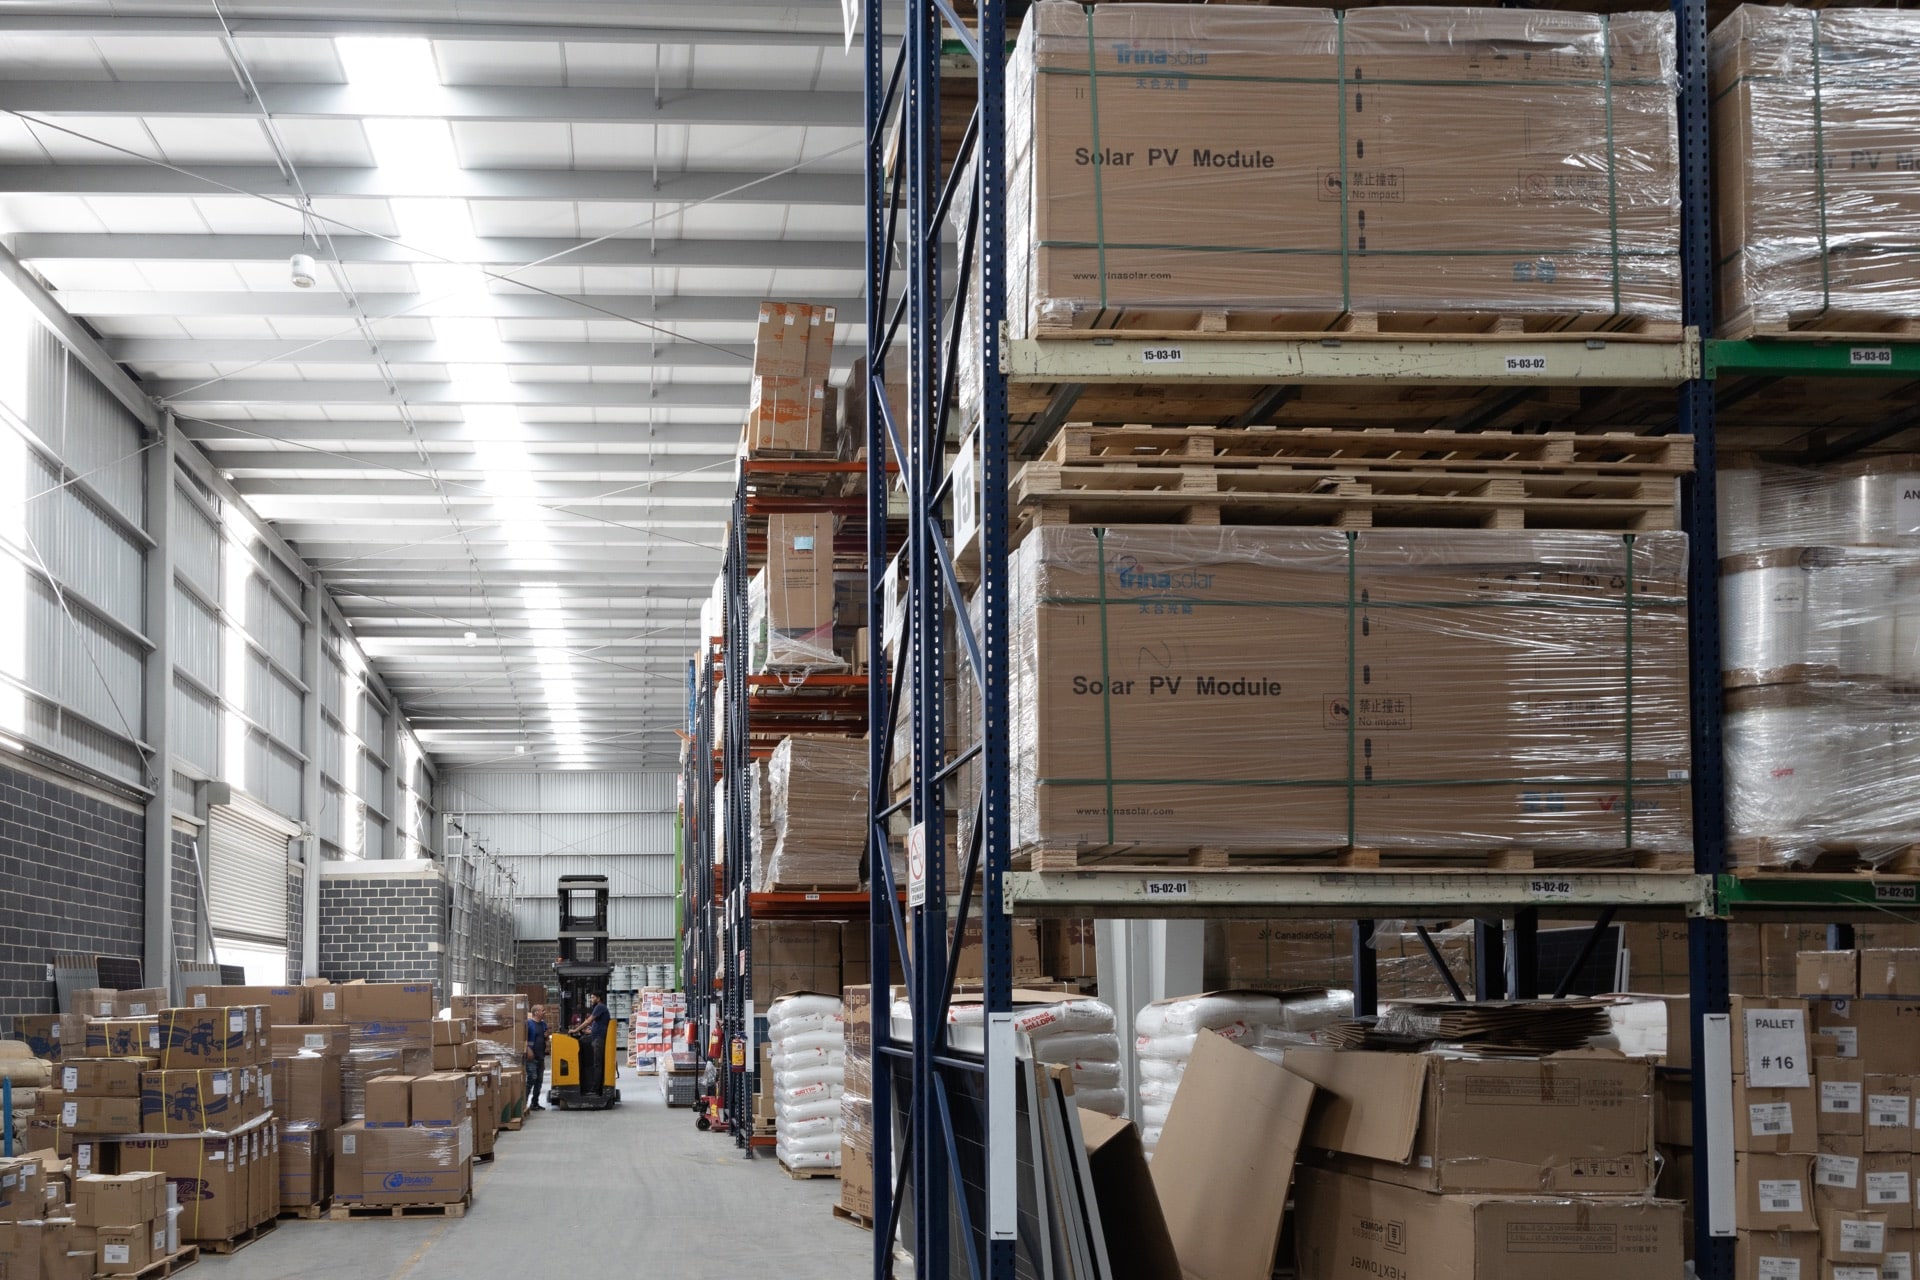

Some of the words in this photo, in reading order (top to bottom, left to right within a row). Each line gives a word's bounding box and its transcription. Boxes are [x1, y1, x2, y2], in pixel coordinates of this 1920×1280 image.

[1075, 148, 1134, 166] Solar
[1148, 148, 1179, 166] PV
[1193, 150, 1274, 168] Module
[1851, 151, 1881, 169] PV
[1352, 190, 1365, 199] No
[1368, 190, 1399, 201] impact
[1144, 350, 1182, 360] 15-03-01
[1852, 351, 1890, 362] 15-03-03
[1507, 359, 1545, 369] 15-03-02
[955, 461, 972, 532] 15
[1149, 676, 1182, 695] PV
[1197, 676, 1282, 697] Module
[1359, 717, 1372, 726] No
[1375, 718, 1406, 728] impact
[1149, 883, 1187, 894] 15-02-01
[1531, 881, 1570, 893] 15-02-02
[1877, 886, 1914, 897] 15-02-03
[1275, 931, 1335, 941] CanadianSola
[1021, 1011, 1049, 1025] Exceed
[1025, 1015, 1057, 1031] mLLDPE
[1755, 1019, 1795, 1029] PALLET
[1761, 1058, 1770, 1069] #
[1775, 1056, 1794, 1069] 16
[1360, 1220, 1384, 1233] POWER
